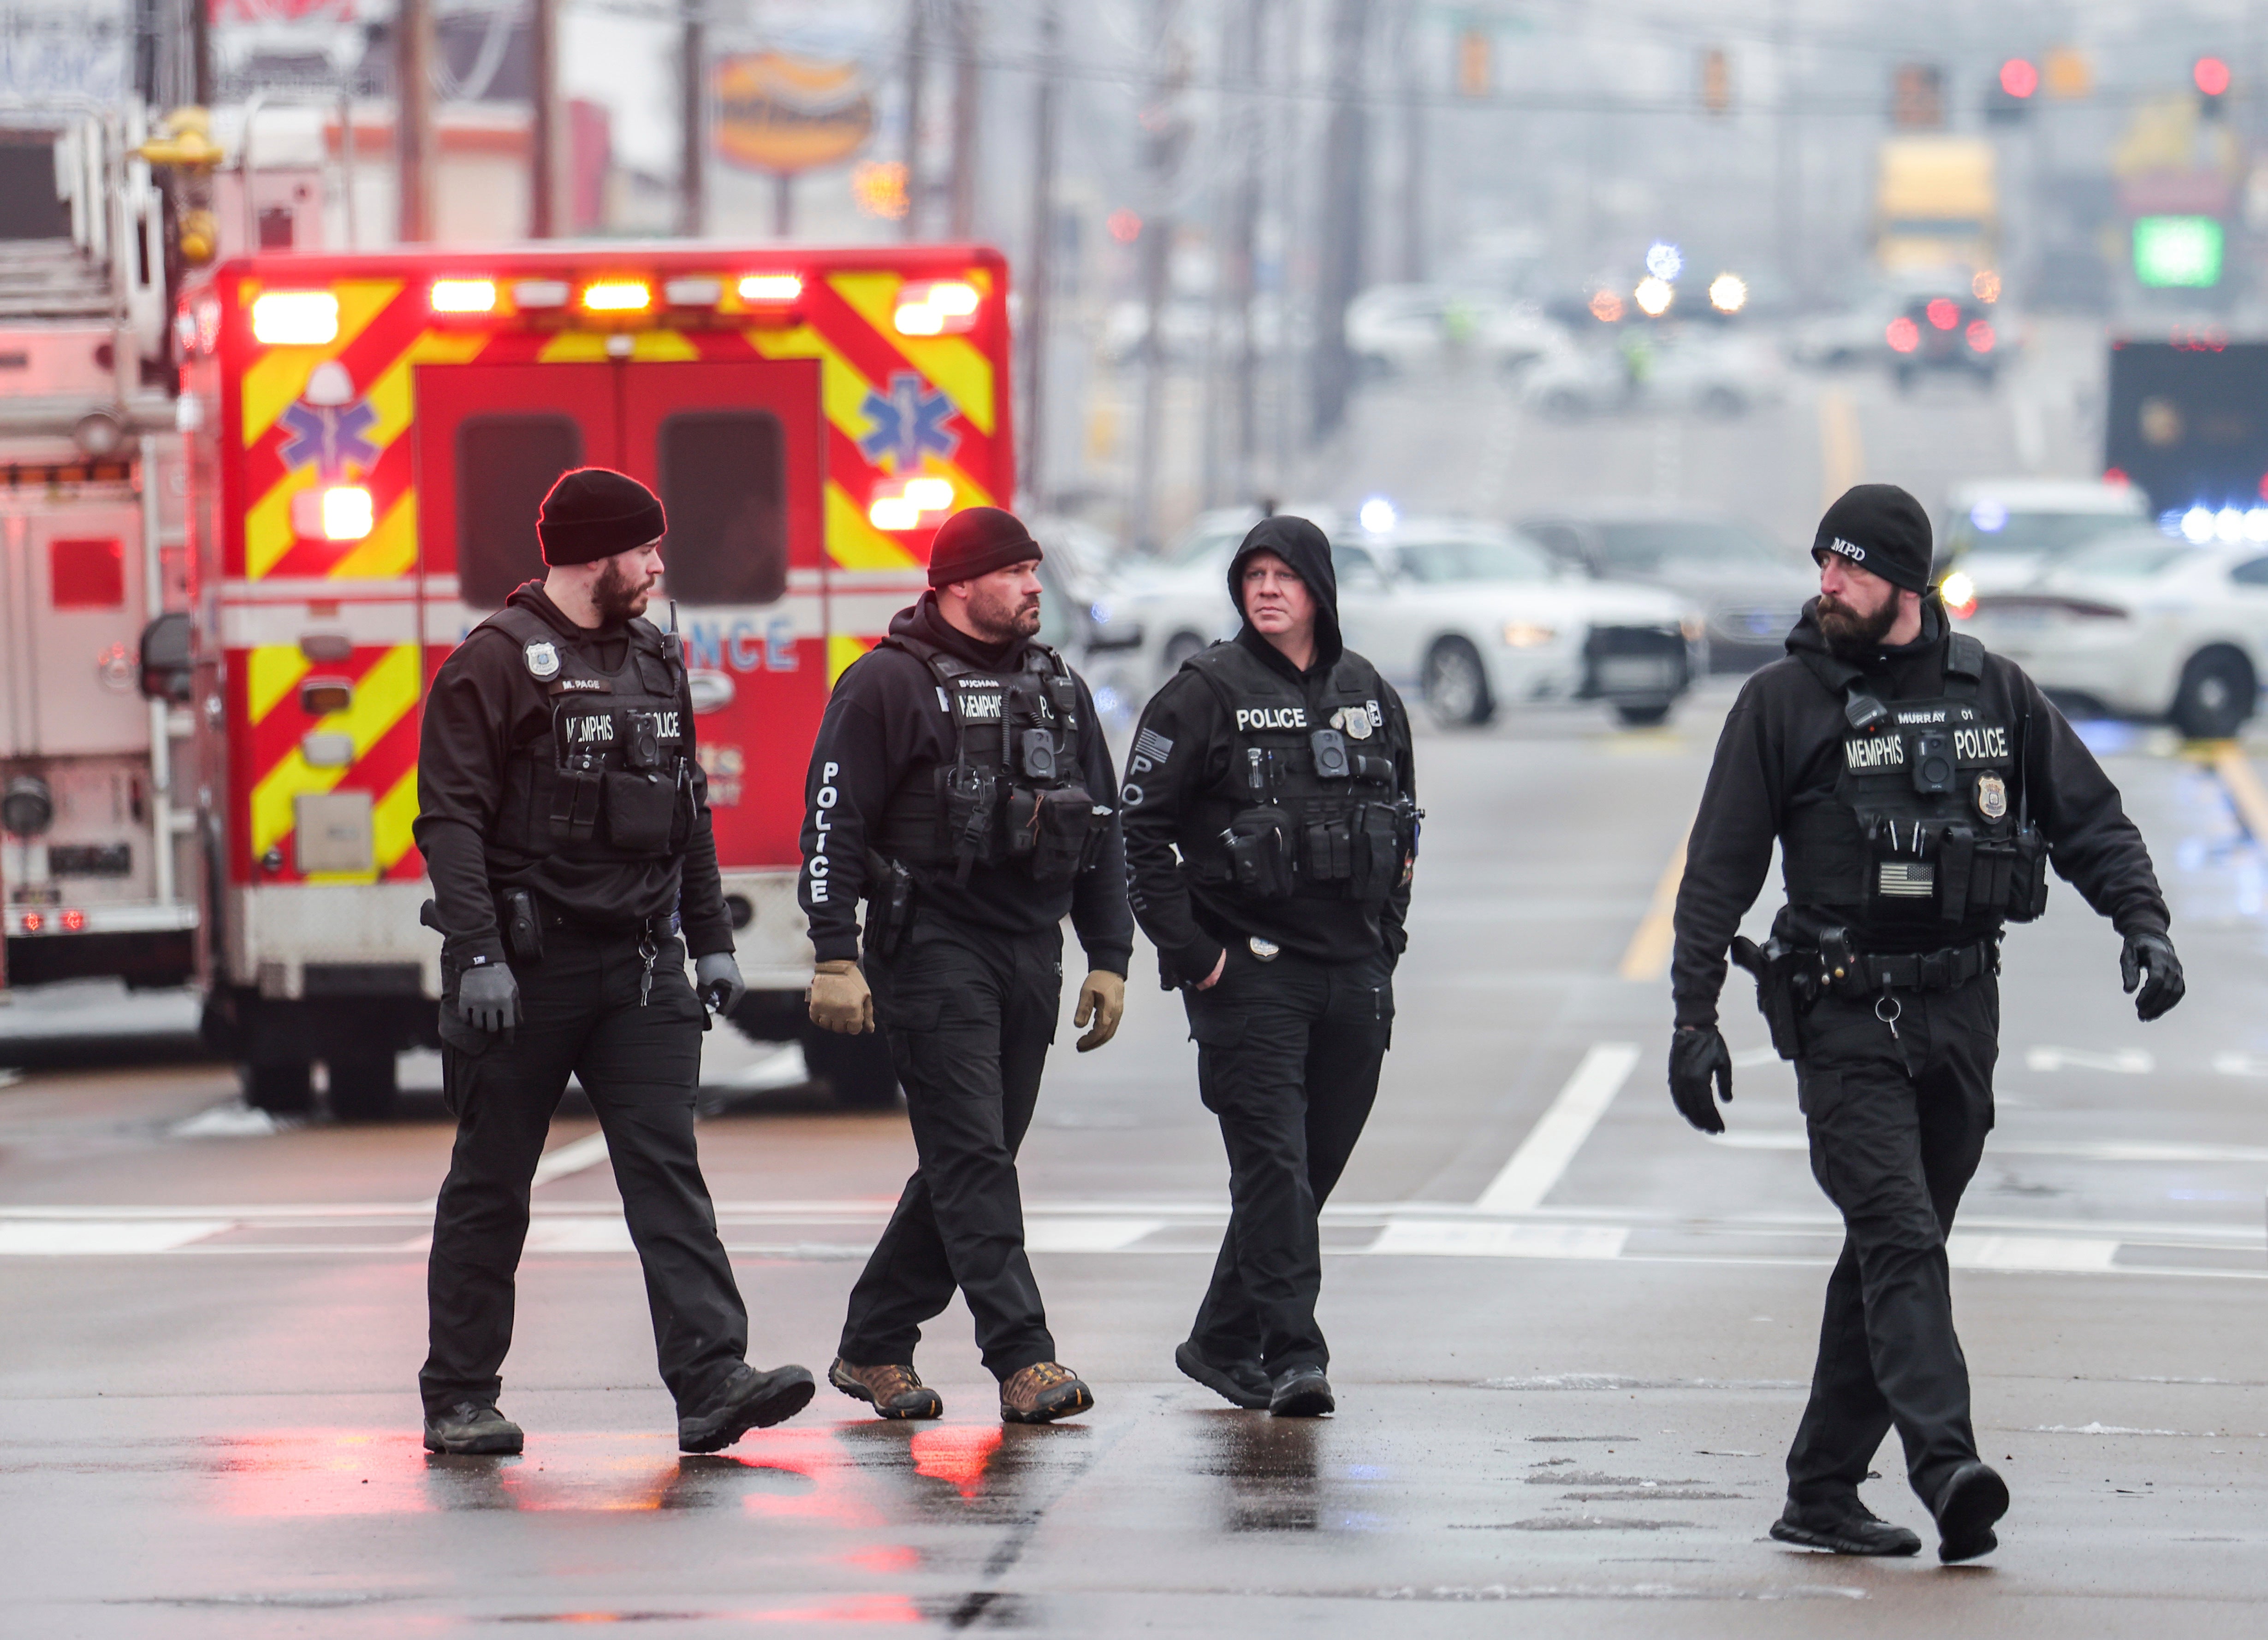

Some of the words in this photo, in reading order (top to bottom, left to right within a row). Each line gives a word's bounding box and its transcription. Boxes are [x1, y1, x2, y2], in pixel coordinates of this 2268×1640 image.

[1830, 537, 1866, 561] MPD
[566, 715, 614, 743] MMPHIS
[645, 711, 680, 738] OLICE
[1236, 708, 1307, 731] POLICE
[1898, 712, 1945, 724] MURRAY
[1961, 710, 1973, 721] 01
[1846, 734, 1904, 768] MEMPHIS
[1954, 727, 2008, 759] POLICE
[809, 762, 839, 903] POLICE
